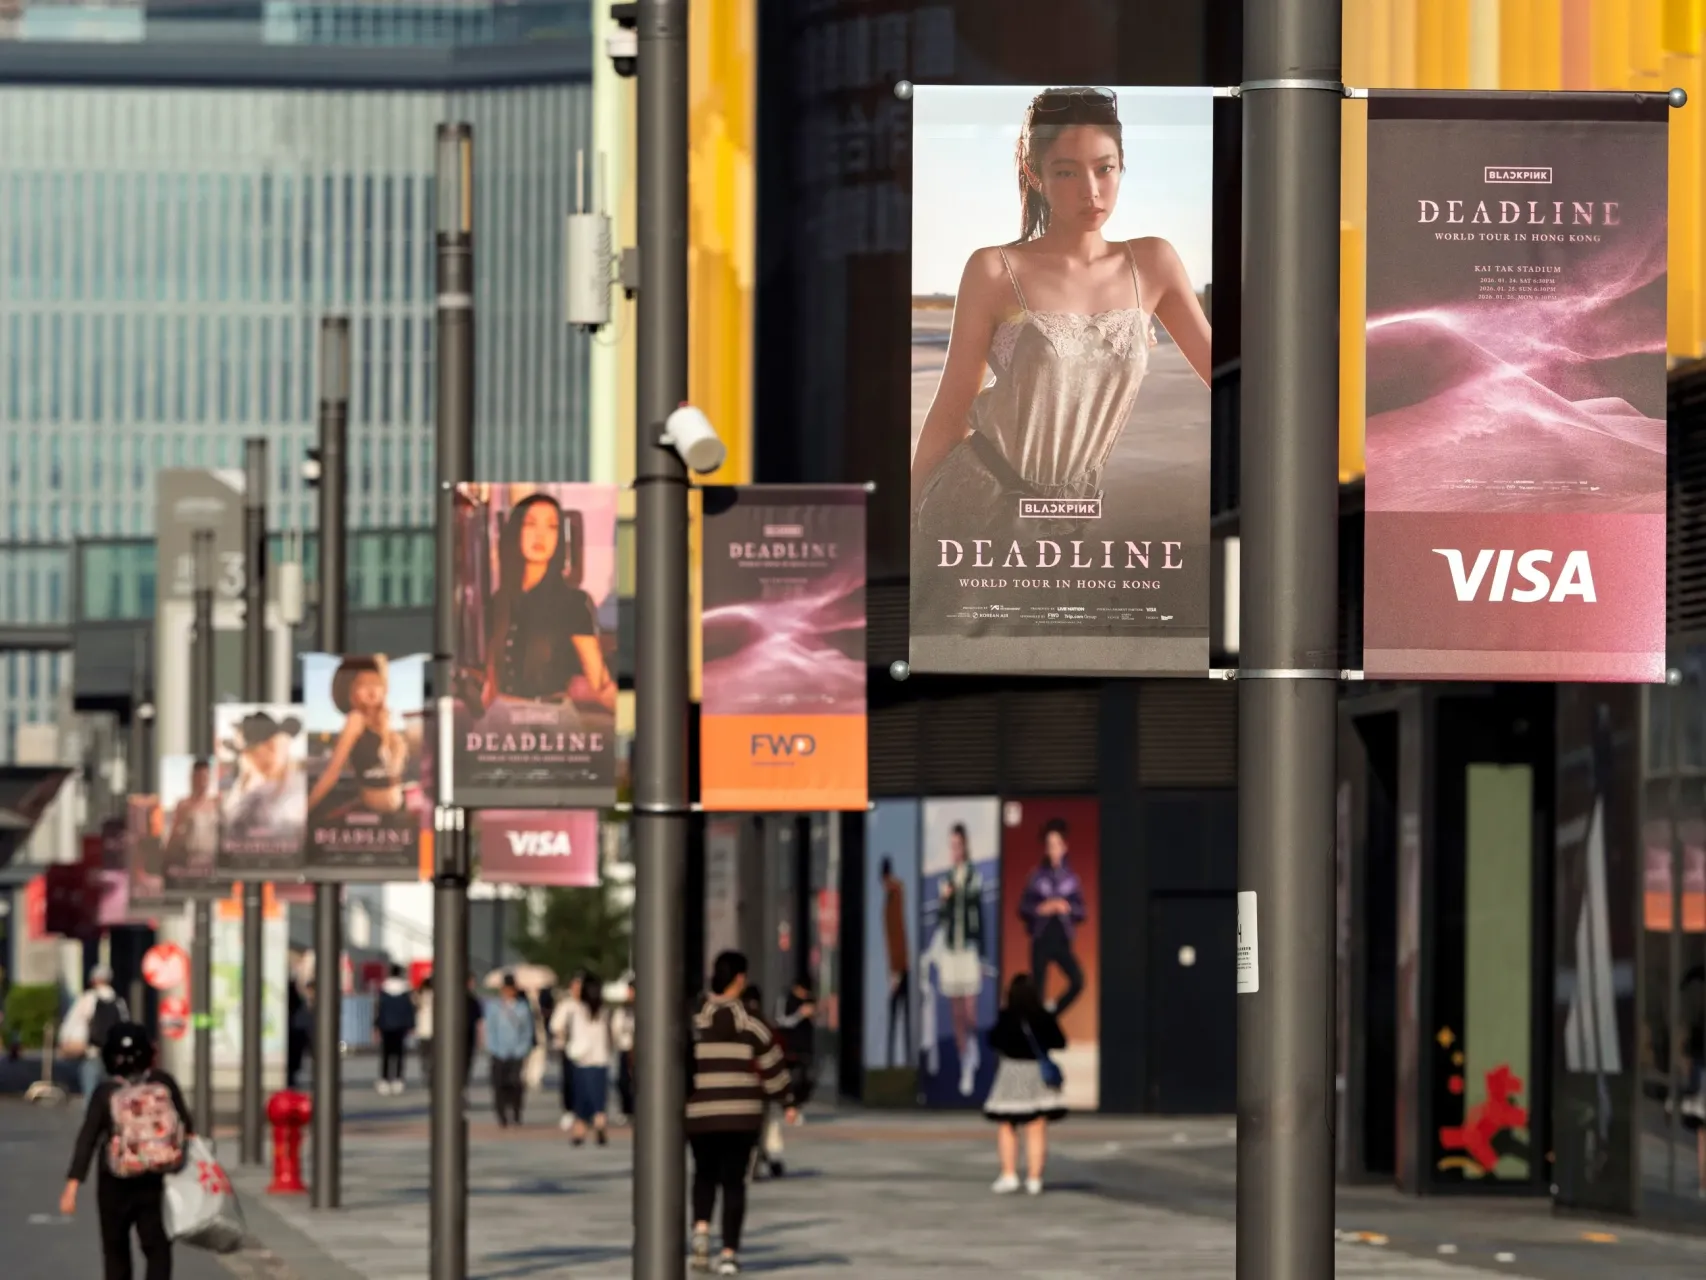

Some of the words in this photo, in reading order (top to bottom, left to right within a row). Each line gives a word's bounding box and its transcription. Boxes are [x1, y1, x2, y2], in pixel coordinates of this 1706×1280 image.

[1489, 171, 1547, 180] BLACKPINK
[1418, 200, 1621, 226] DEADLINE
[1435, 232, 1475, 241] WORLD
[1478, 233, 1510, 242] TOUR
[1514, 233, 1527, 242] IN
[1531, 233, 1564, 242] HONG
[1569, 234, 1601, 243] KONG
[1517, 265, 1561, 273] STADIUM
[1024, 504, 1096, 514] BLACKPINK
[729, 541, 838, 559] DEADLINE
[937, 539, 1183, 569] DEADLINE
[959, 578, 1007, 588] WORLD
[1013, 579, 1050, 588] TOUR
[1056, 579, 1071, 588] IN
[1077, 579, 1116, 589] HONG
[1122, 580, 1161, 589] KONG
[1432, 548, 1597, 603] VISA
[466, 732, 604, 751] DEADLINE
[751, 734, 816, 756] FWD
[505, 830, 571, 856] VISA
